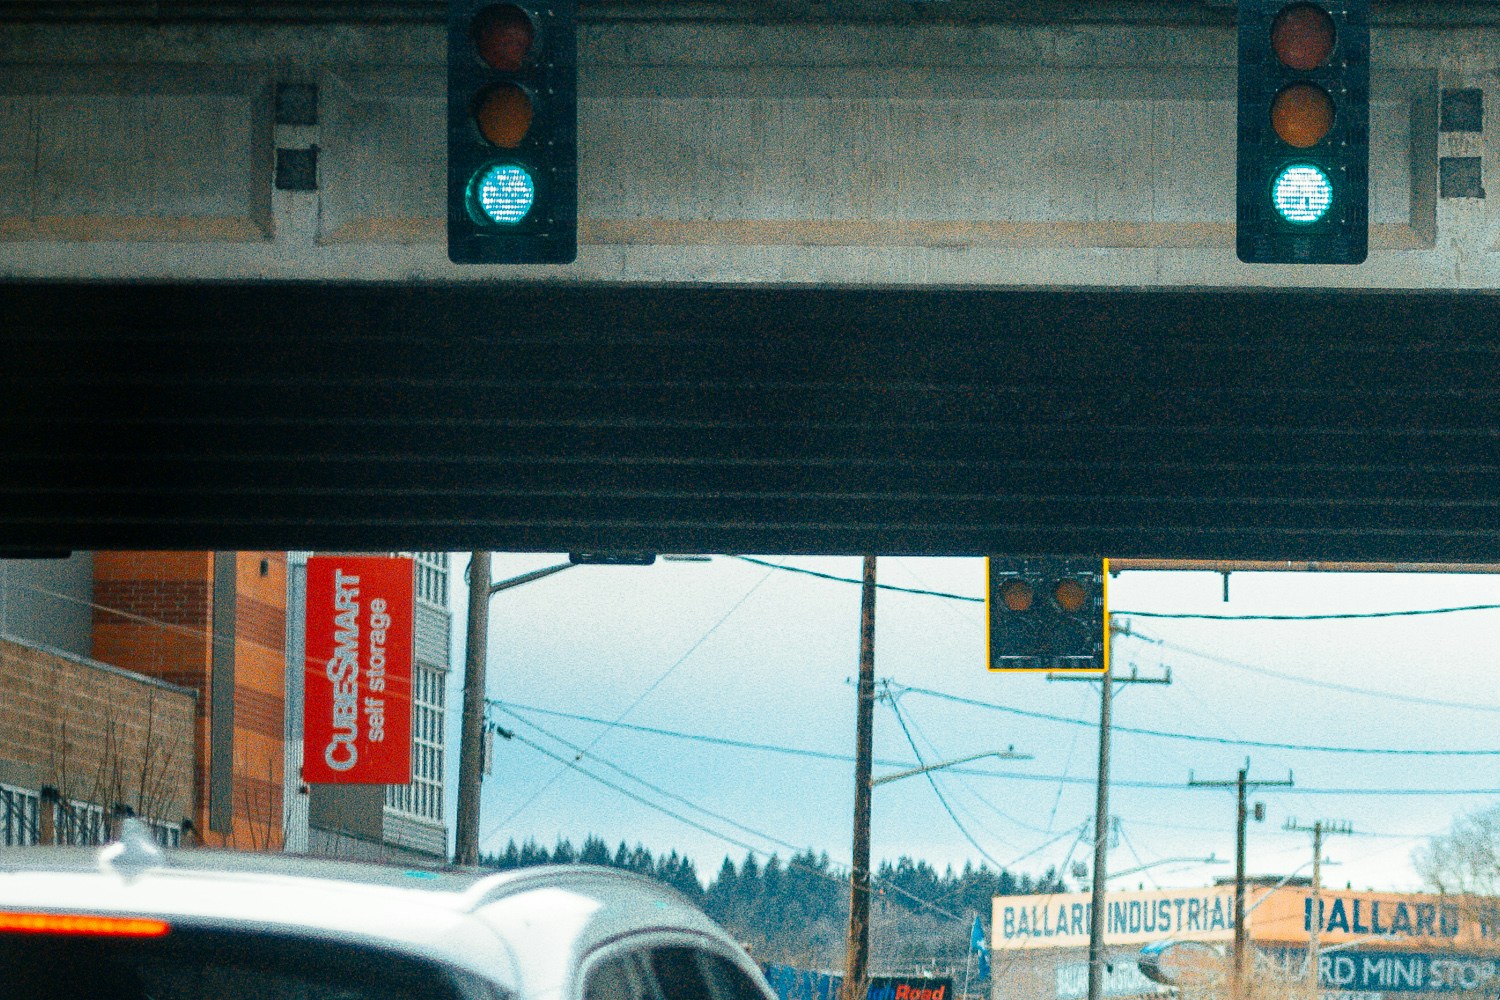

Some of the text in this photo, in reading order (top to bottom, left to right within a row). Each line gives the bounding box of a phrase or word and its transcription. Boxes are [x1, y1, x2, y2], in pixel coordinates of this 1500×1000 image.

[365, 598, 391, 742] self storage
[1107, 895, 1236, 934] INDUSTRIAL
[1363, 957, 1423, 987] MINI
